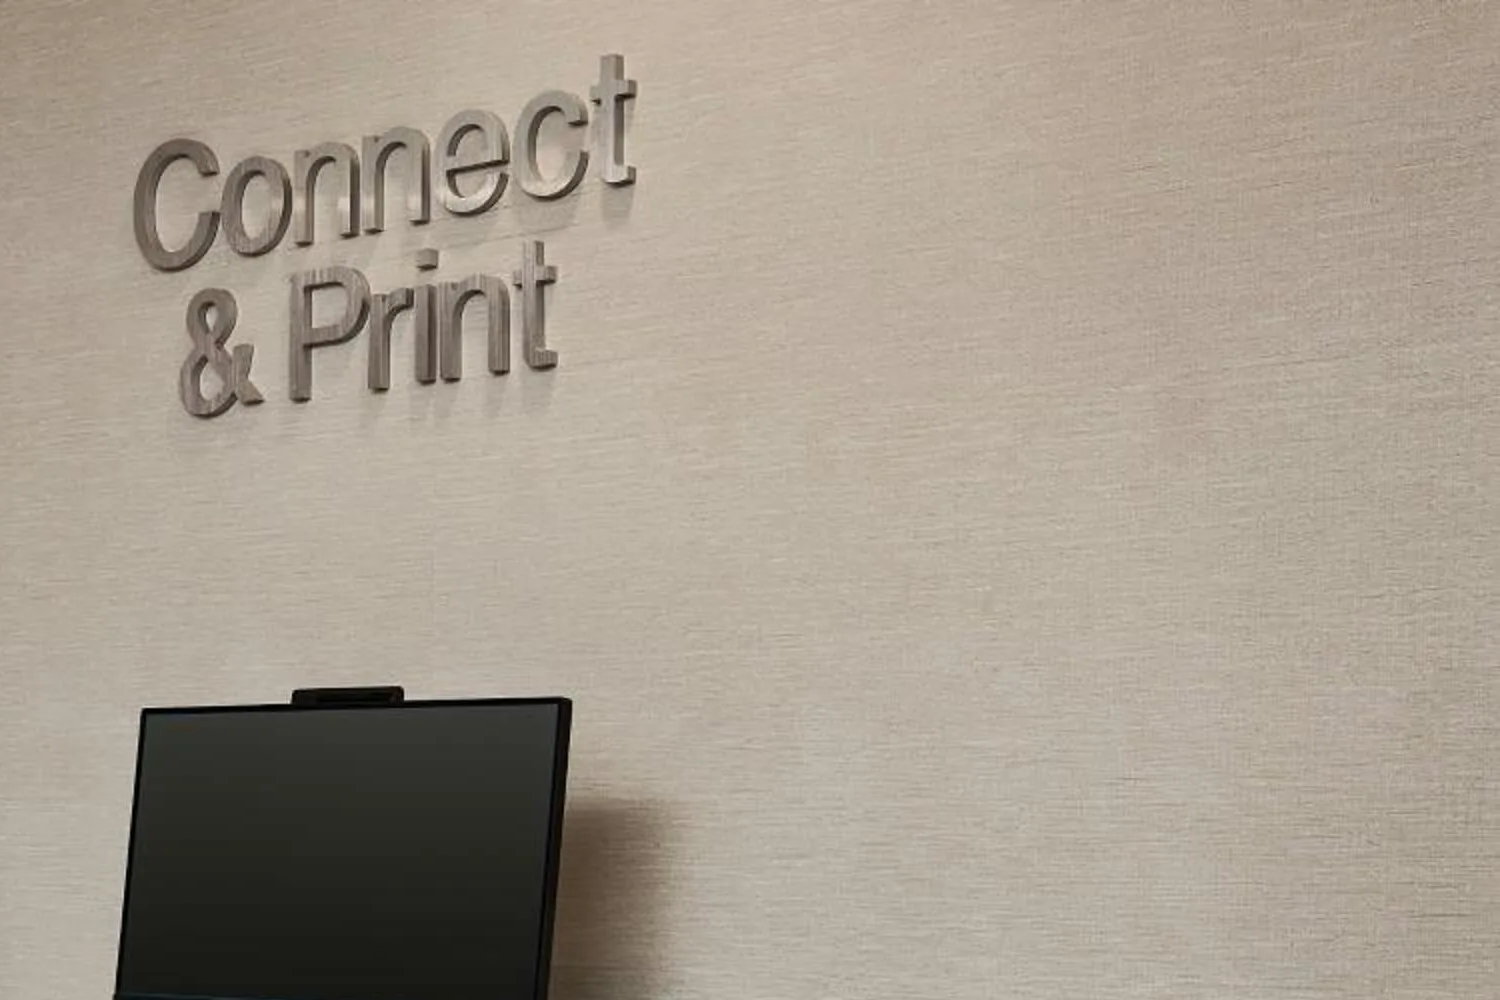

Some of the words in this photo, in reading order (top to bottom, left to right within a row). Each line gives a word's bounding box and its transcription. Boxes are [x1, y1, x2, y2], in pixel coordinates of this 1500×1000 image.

[133, 53, 637, 272] Connect
[179, 287, 264, 418] &
[289, 240, 558, 403] Print
